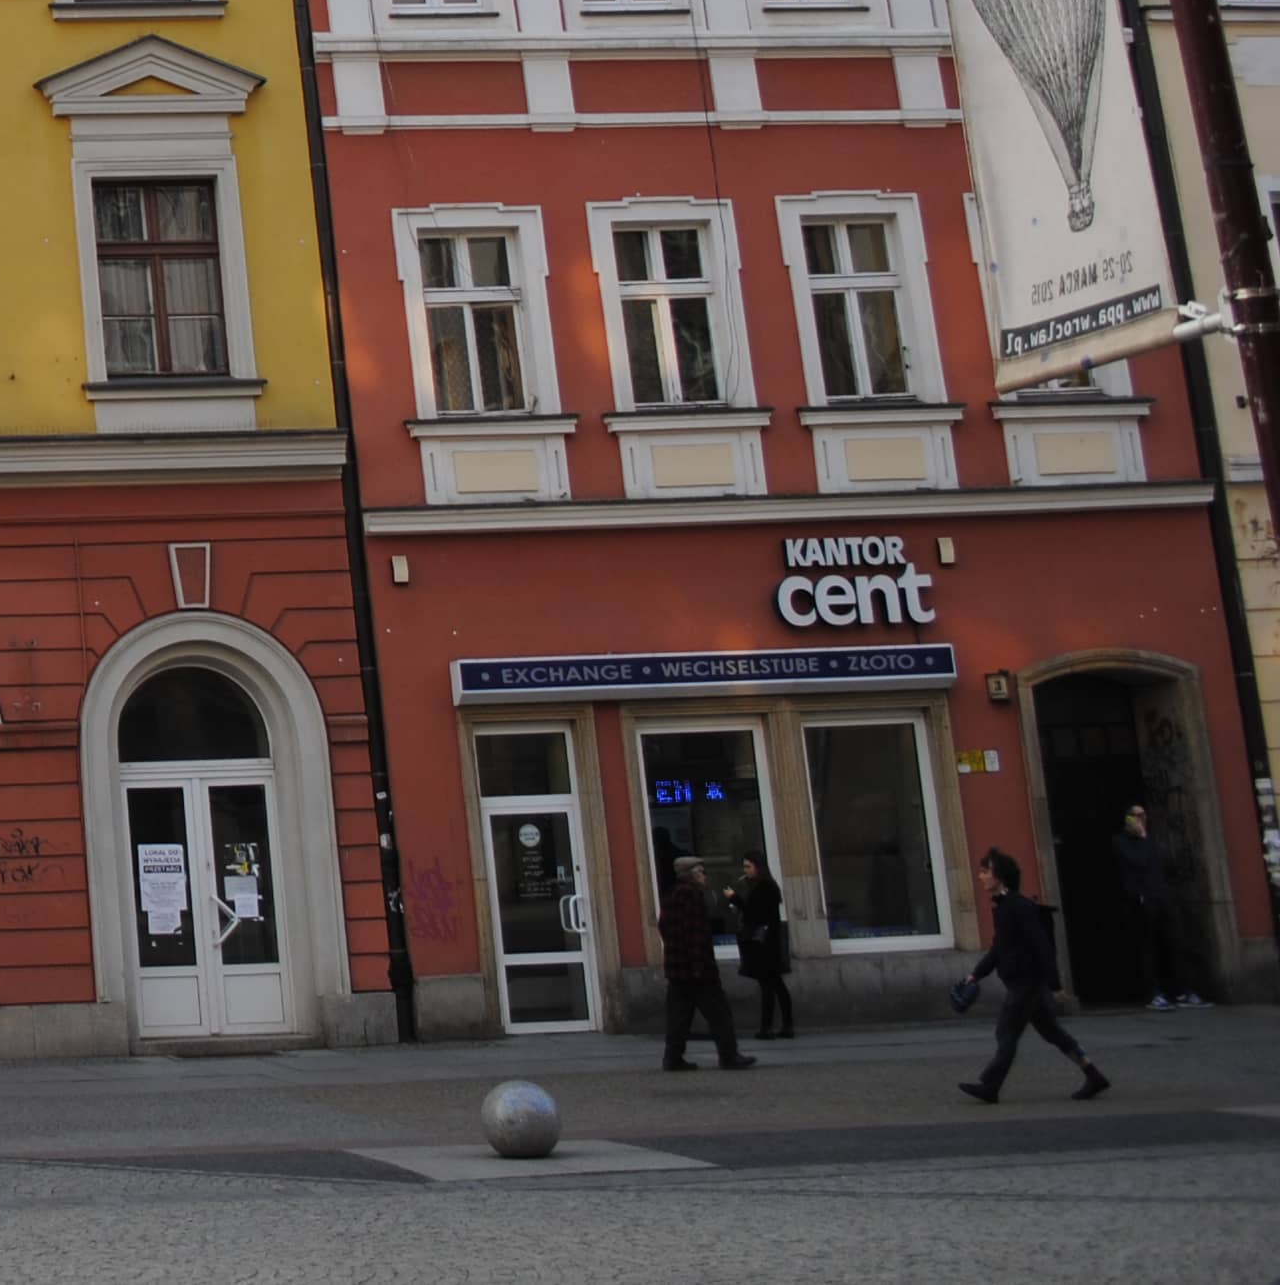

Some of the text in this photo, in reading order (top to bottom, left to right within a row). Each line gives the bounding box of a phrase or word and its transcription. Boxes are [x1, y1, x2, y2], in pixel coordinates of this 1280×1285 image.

[785, 535, 906, 567] KANTOR
[777, 562, 936, 627] cent
[501, 654, 915, 684] EXCHANGE WECHSELSTUBE ZŁOTO
